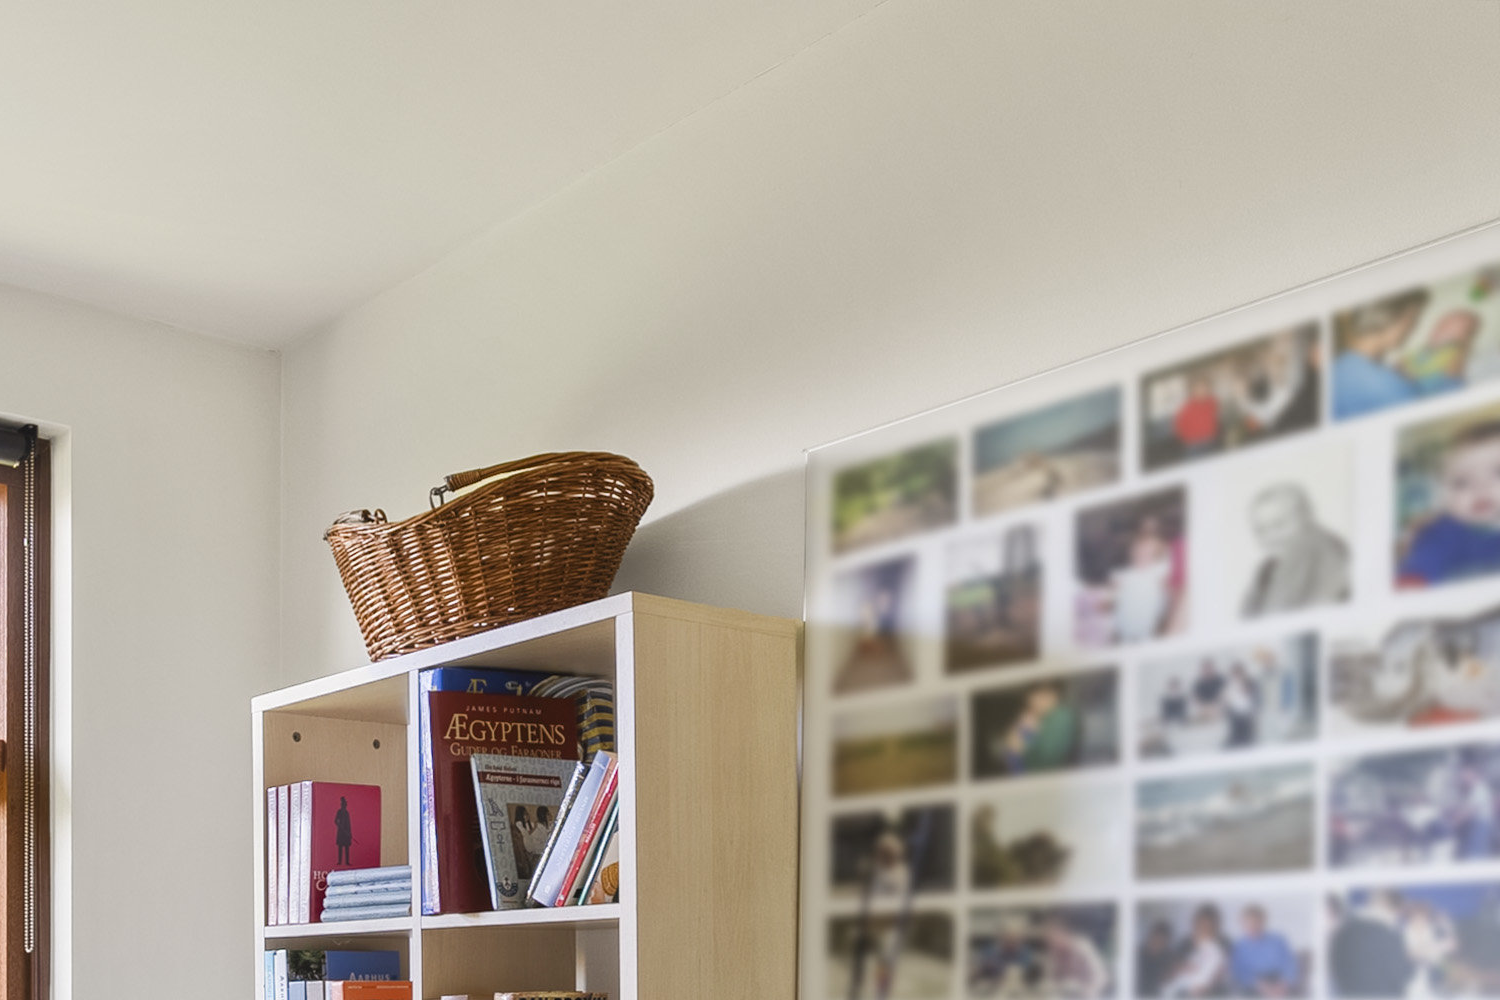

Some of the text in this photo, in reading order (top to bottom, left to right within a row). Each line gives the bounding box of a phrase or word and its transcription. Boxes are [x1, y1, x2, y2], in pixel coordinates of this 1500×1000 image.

[466, 705, 542, 715] JAMES PUTNAM
[443, 713, 566, 745] ÆGYPTENS
